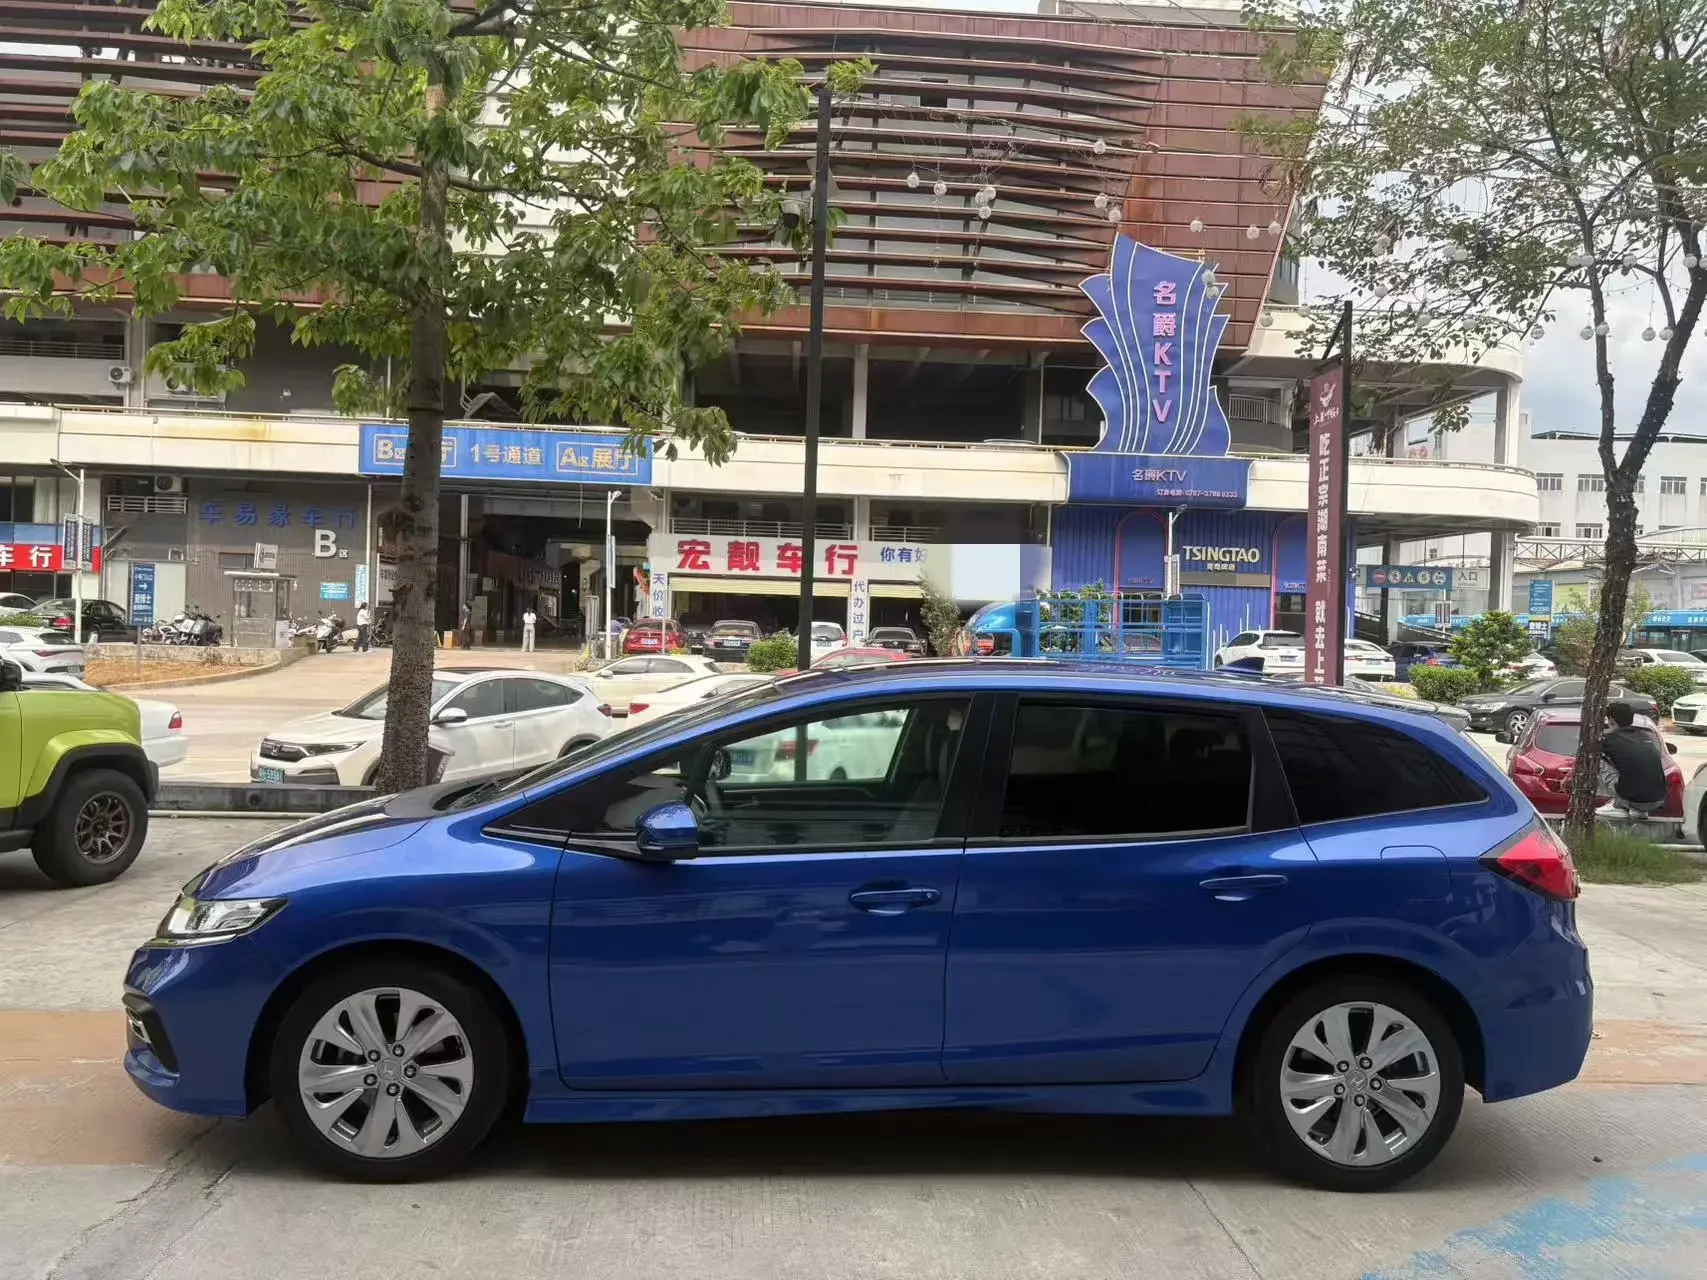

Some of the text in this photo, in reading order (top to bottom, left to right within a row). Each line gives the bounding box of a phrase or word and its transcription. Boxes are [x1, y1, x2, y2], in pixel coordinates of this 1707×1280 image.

[1152, 280, 1177, 423] 名爵KTV
[470, 445, 543, 465] 1号通道
[560, 447, 637, 470] A区展厅
[314, 529, 348, 558] B区
[677, 538, 859, 576] 宏靓车行
[1182, 545, 1260, 563] TSINGTAO
[1458, 570, 1478, 581] 入口
